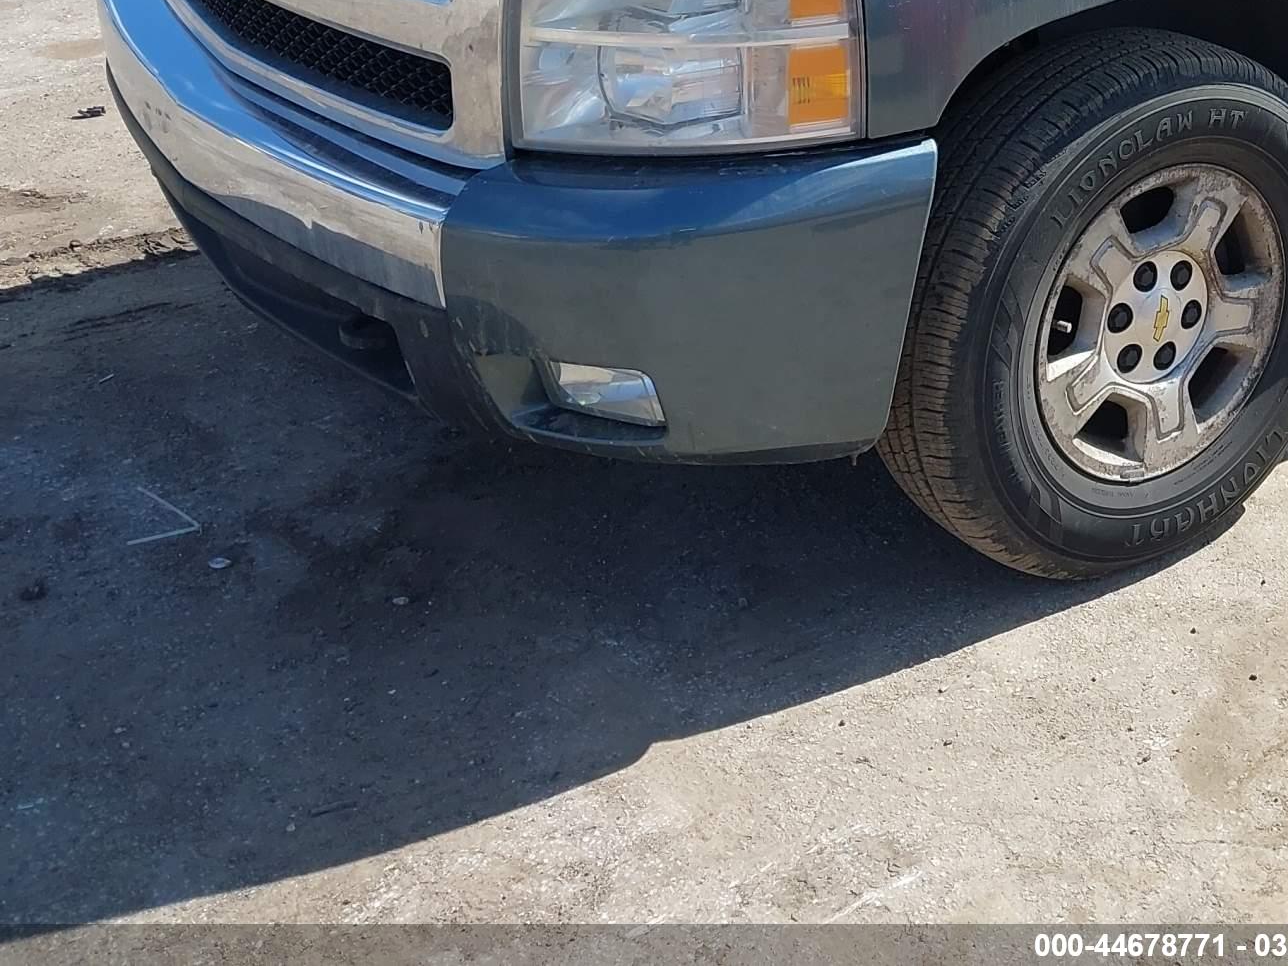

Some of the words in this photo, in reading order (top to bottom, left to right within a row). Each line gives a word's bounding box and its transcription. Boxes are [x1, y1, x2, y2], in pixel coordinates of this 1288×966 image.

[1051, 110, 1194, 230] LIONCLAW
[1208, 107, 1248, 130] HT
[1124, 426, 1288, 547] LIONHART
